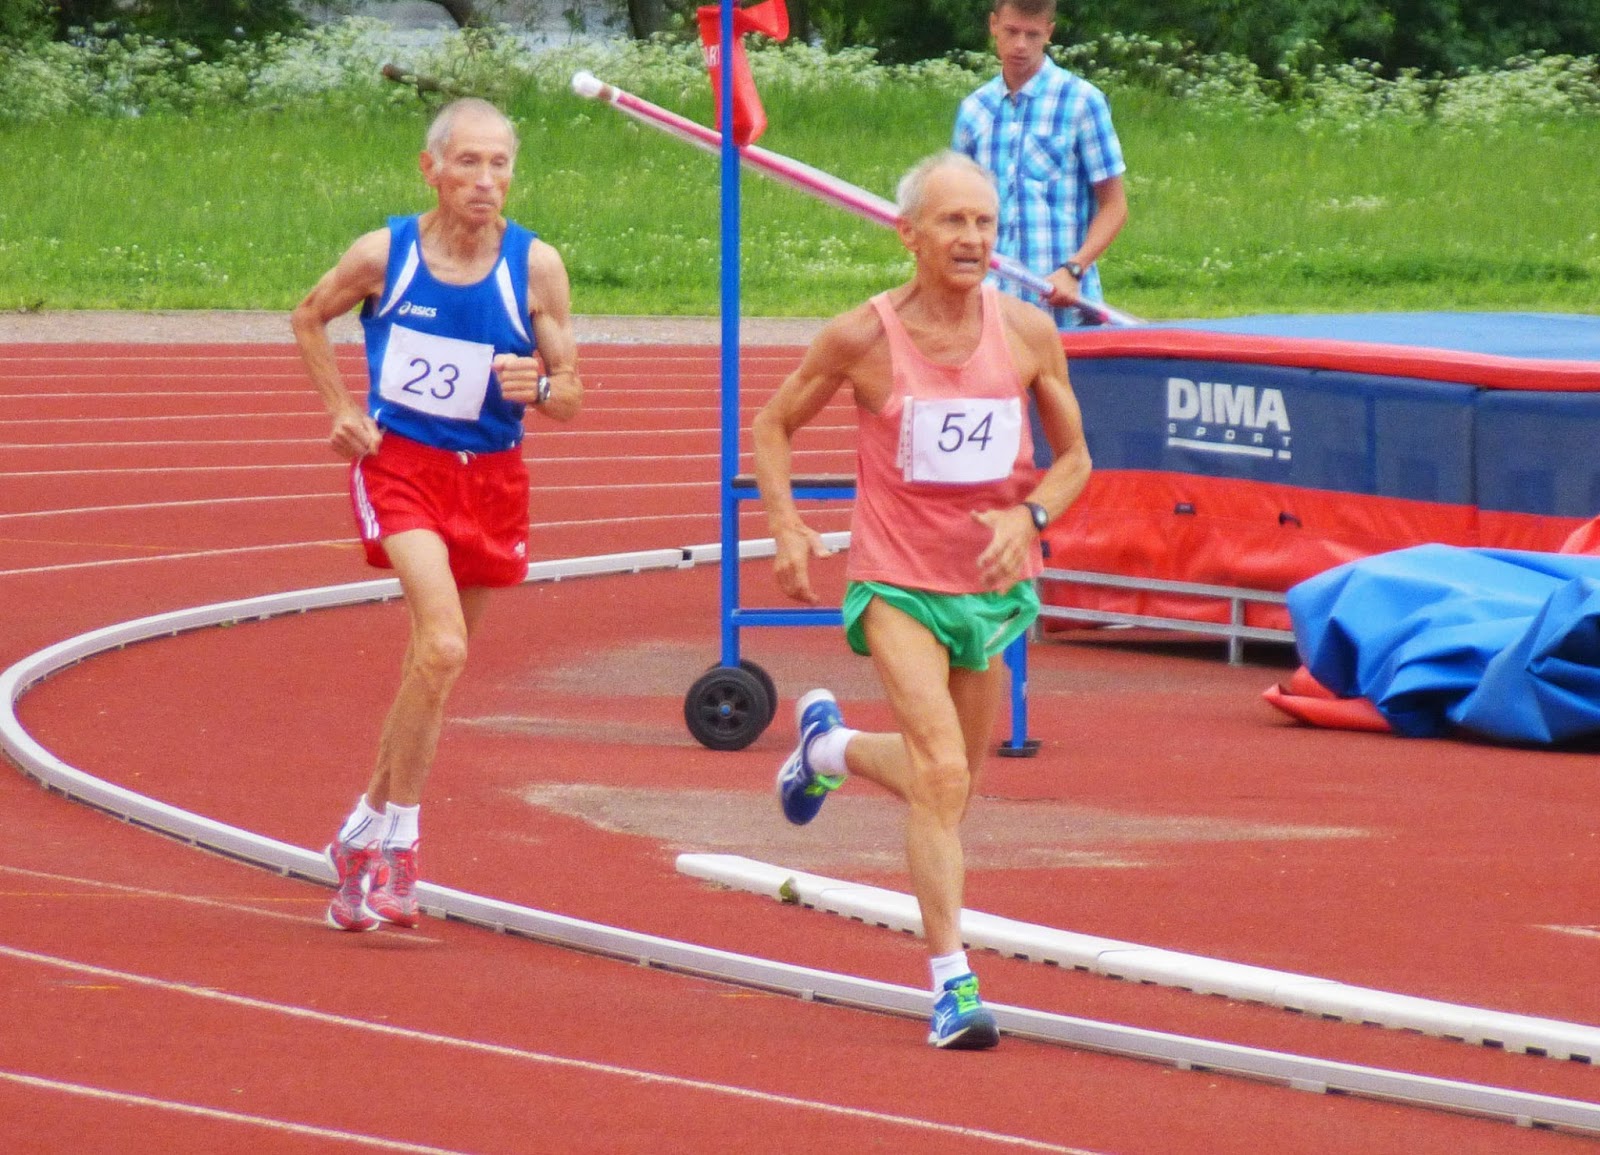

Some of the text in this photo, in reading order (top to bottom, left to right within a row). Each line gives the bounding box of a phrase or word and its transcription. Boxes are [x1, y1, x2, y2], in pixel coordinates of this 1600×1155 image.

[410, 304, 438, 318] asics
[401, 357, 460, 400] 23
[1167, 377, 1291, 432] DIMA
[938, 411, 993, 453] 54
[1168, 422, 1292, 447] SPORT
